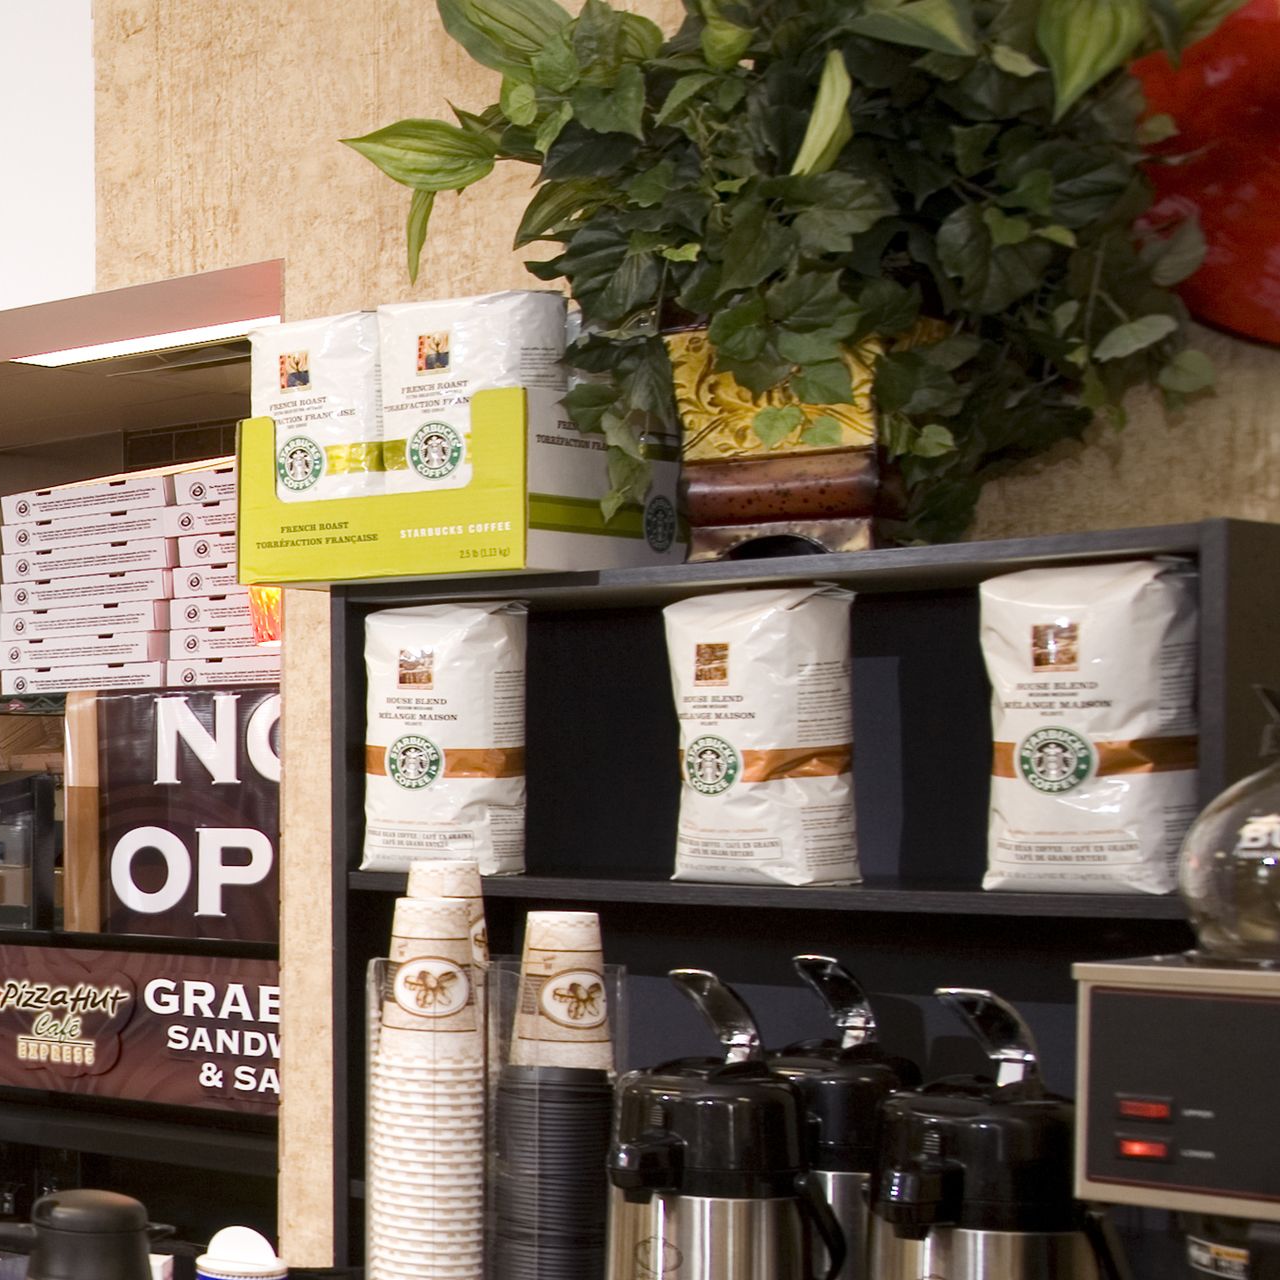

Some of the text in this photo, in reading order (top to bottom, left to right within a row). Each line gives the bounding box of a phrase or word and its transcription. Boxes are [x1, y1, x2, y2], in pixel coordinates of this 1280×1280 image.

[411, 423, 462, 450] STARBUCKS
[278, 437, 322, 465] STARBUCKS
[416, 463, 455, 479] COFFEE
[283, 474, 317, 490] COFFEE
[280, 521, 349, 533] FRENCH ROAST
[399, 521, 511, 538] STARBUCKS COFFEE
[256, 533, 378, 550] TORRÉFACTION FRANÇAISE
[460, 550, 471, 559] 2.5
[498, 547, 511, 558] kg)
[1054, 682, 1098, 690] BLEND
[386, 697, 447, 705] HOUSE BLEND
[1060, 700, 1112, 708] MAISON
[419, 713, 458, 721] MAISON
[391, 737, 438, 760] STARBUCKS
[1022, 729, 1089, 757] STARBUCKS
[395, 772, 432, 788] COFFEE
[692, 778, 729, 794] COFFEE
[1028, 773, 1080, 792] COFFEE
[110, 825, 273, 917] OP
[0, 983, 128, 1015] Pizza Hut
[35, 1013, 80, 1043] Café
[18, 1041, 94, 1064] EXPRESS
[199, 1063, 223, 1088] &
